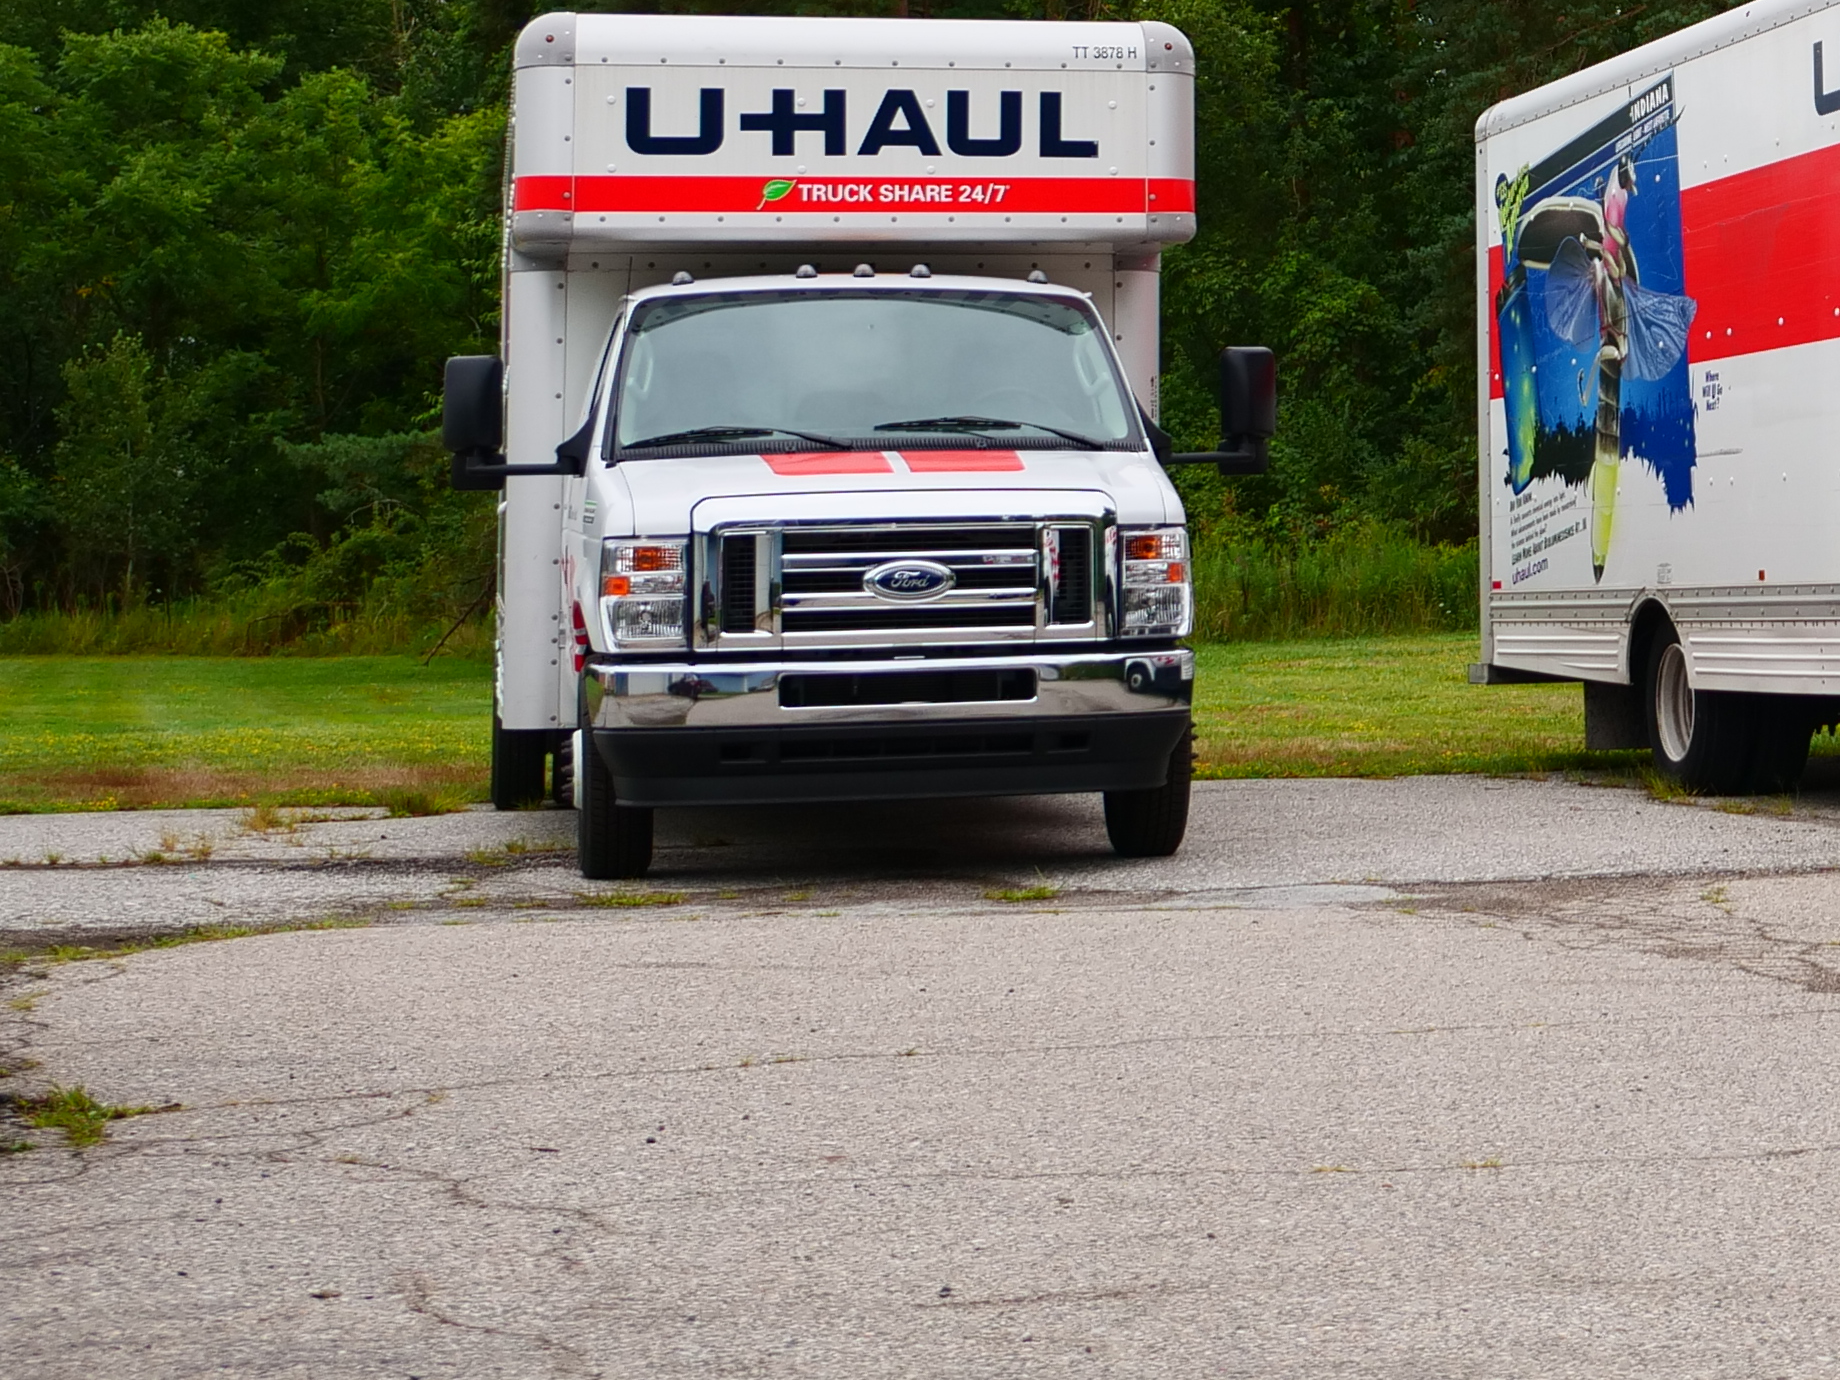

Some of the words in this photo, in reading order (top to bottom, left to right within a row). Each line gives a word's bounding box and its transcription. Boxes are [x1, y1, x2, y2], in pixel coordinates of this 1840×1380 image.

[1072, 46, 1089, 59] TT
[1093, 46, 1124, 59] 3878
[1127, 47, 1137, 59] H
[1629, 83, 1669, 123] INDIANA
[626, 87, 1099, 158] U-HAUL
[798, 184, 873, 202] TRUCK
[879, 184, 953, 202] SHARE
[958, 183, 1008, 204] 24/7
[890, 570, 931, 588] Ford
[1512, 557, 1549, 585] uhaul.com
